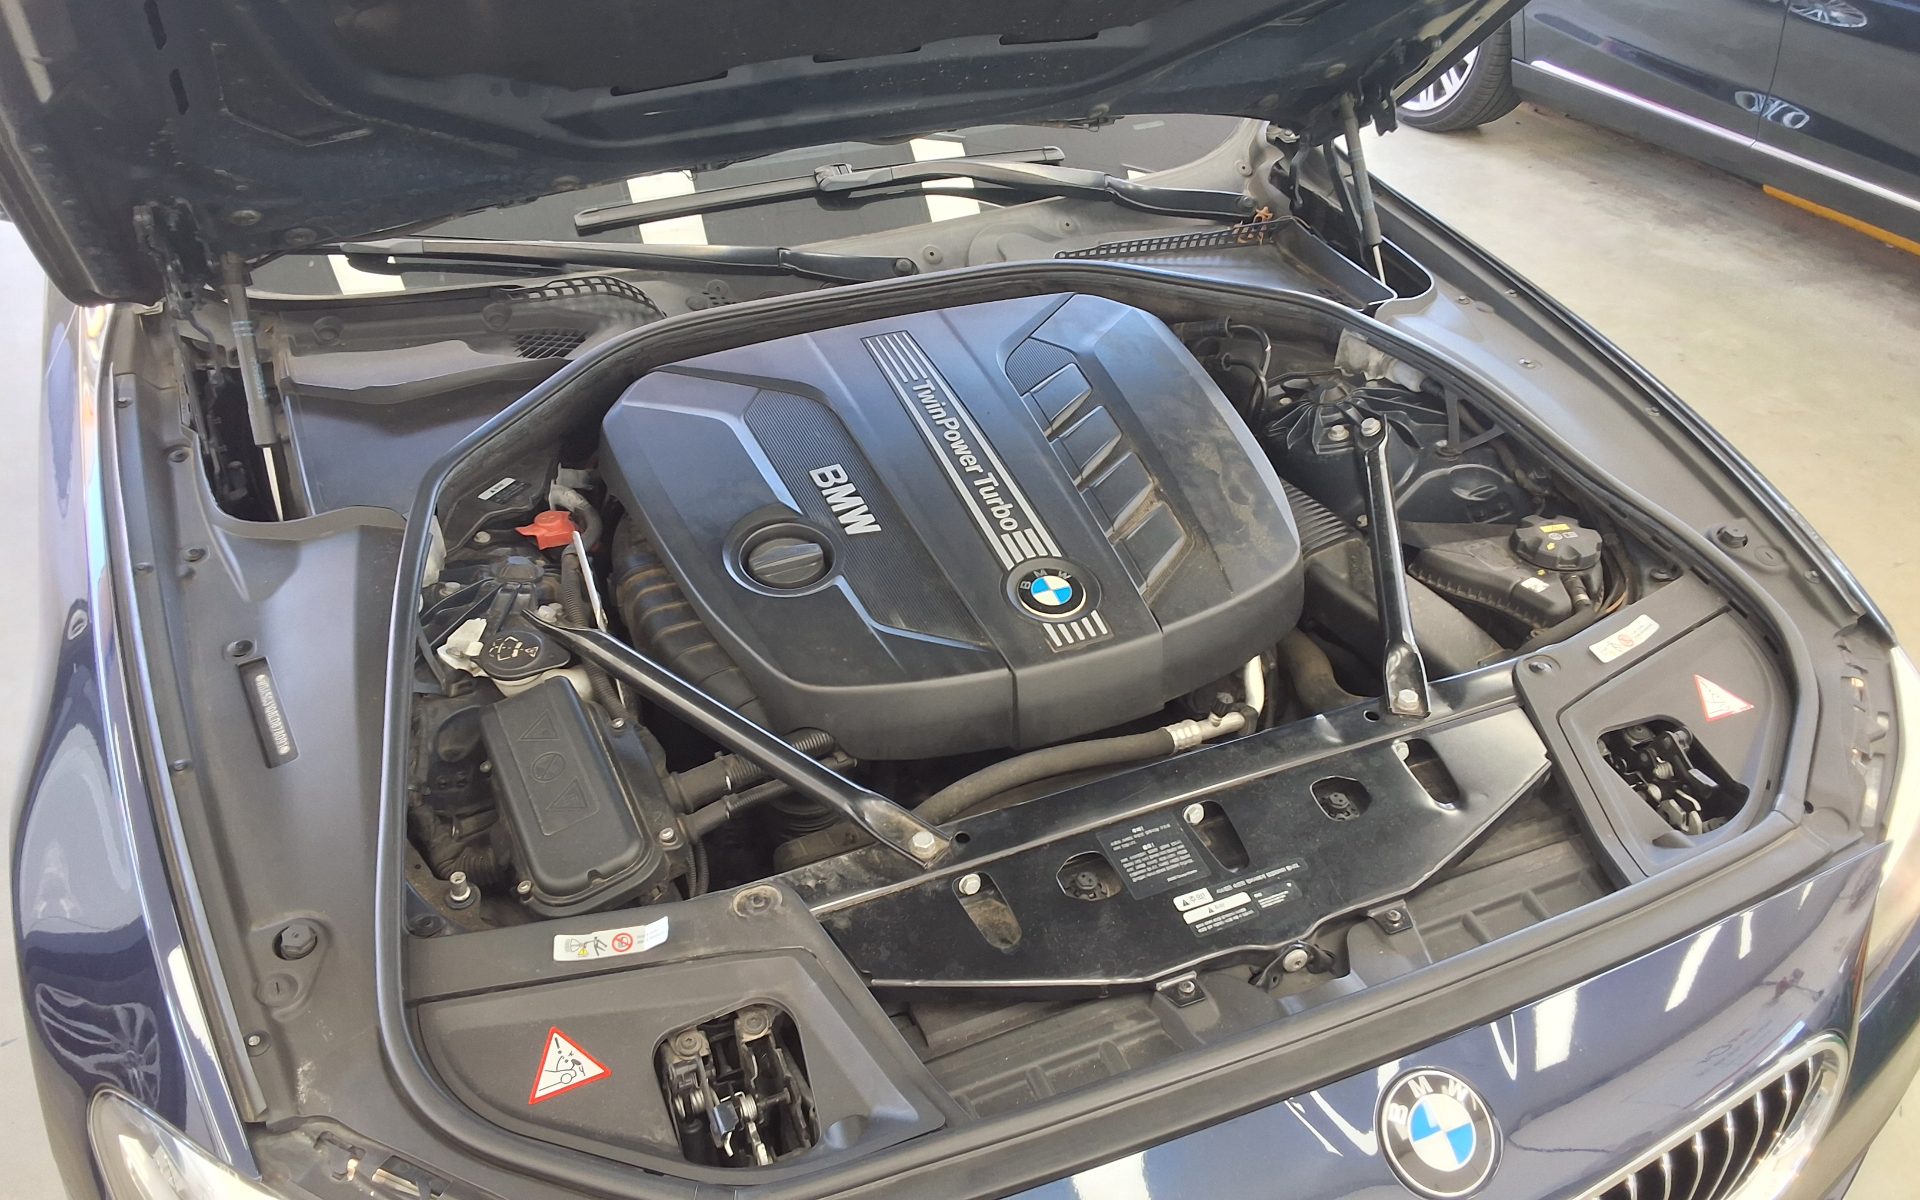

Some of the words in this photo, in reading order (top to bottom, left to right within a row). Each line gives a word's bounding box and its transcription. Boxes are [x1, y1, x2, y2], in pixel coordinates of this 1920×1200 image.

[912, 378, 983, 475] TwinPower
[973, 472, 1018, 530] Turbo
[809, 463, 882, 535] BMW
[1019, 569, 1072, 590] BMW
[1387, 1075, 1470, 1125] BMW
